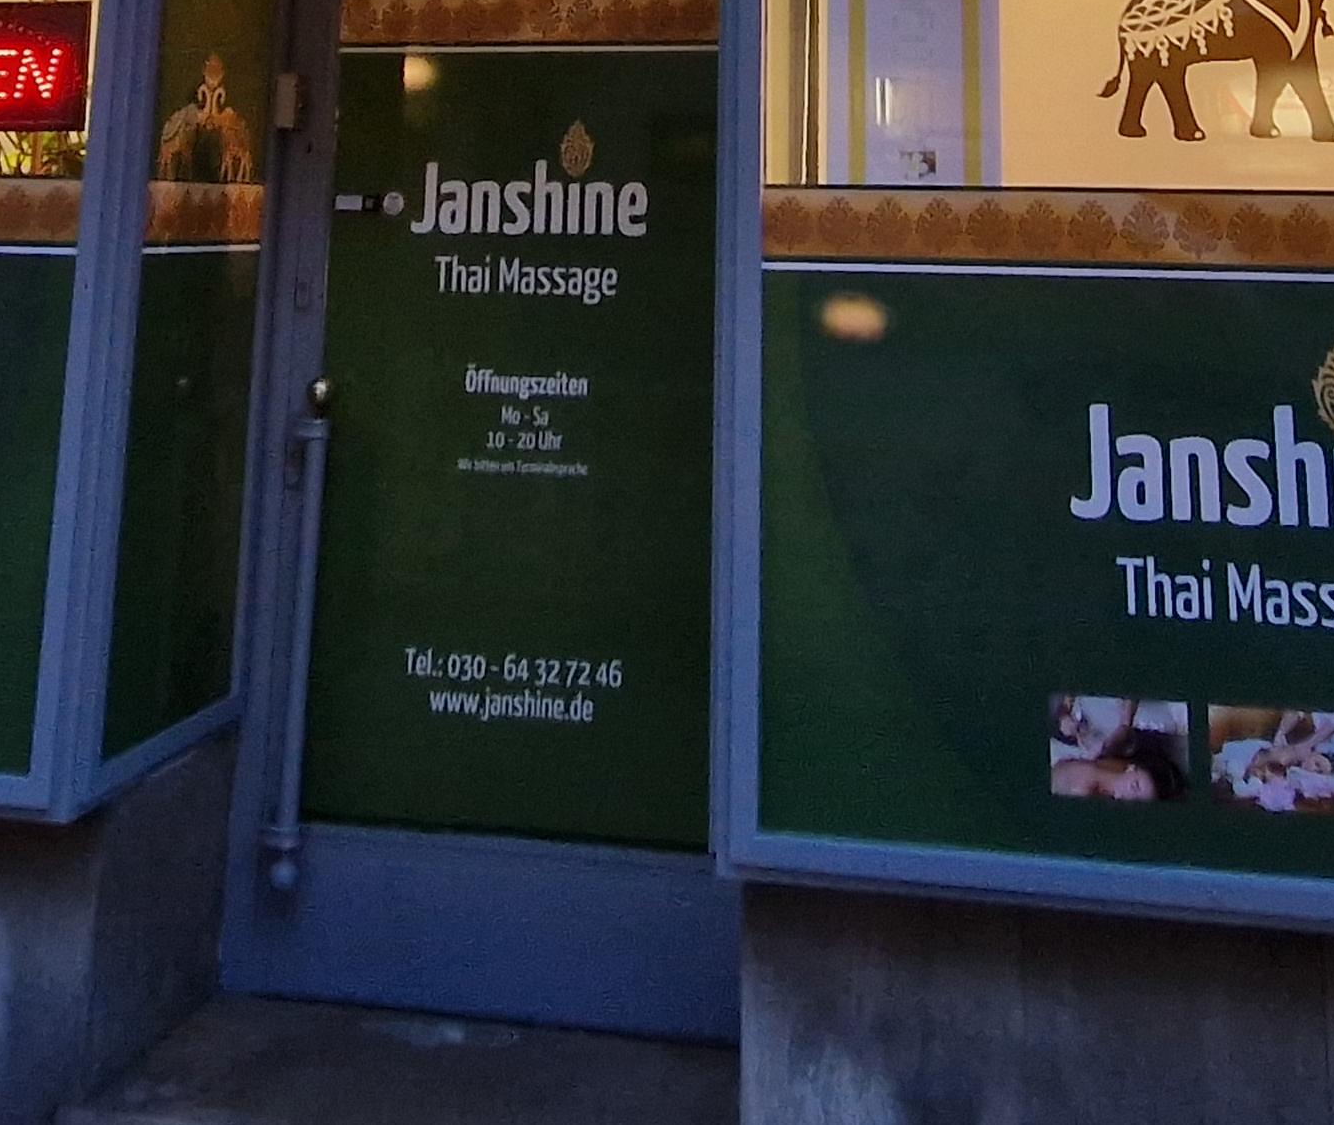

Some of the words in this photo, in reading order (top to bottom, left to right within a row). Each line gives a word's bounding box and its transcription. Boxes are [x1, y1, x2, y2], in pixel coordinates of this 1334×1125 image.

[410, 158, 649, 237] Janshine
[434, 254, 491, 293] Thai
[498, 256, 618, 305] Massage
[465, 363, 588, 400] Öffnungszeiten
[501, 405, 521, 425] Mo
[533, 405, 549, 426] Sa
[486, 431, 505, 449] 10
[517, 431, 536, 450] 20
[538, 430, 563, 451] Uhr
[1115, 555, 1213, 621] Thai
[405, 647, 443, 677] Tel.:
[447, 653, 486, 681] 030
[503, 653, 529, 682] 64
[535, 658, 560, 686] 32
[566, 660, 591, 688] 72
[595, 659, 623, 688] 46
[429, 686, 594, 722] www.janshine.de
